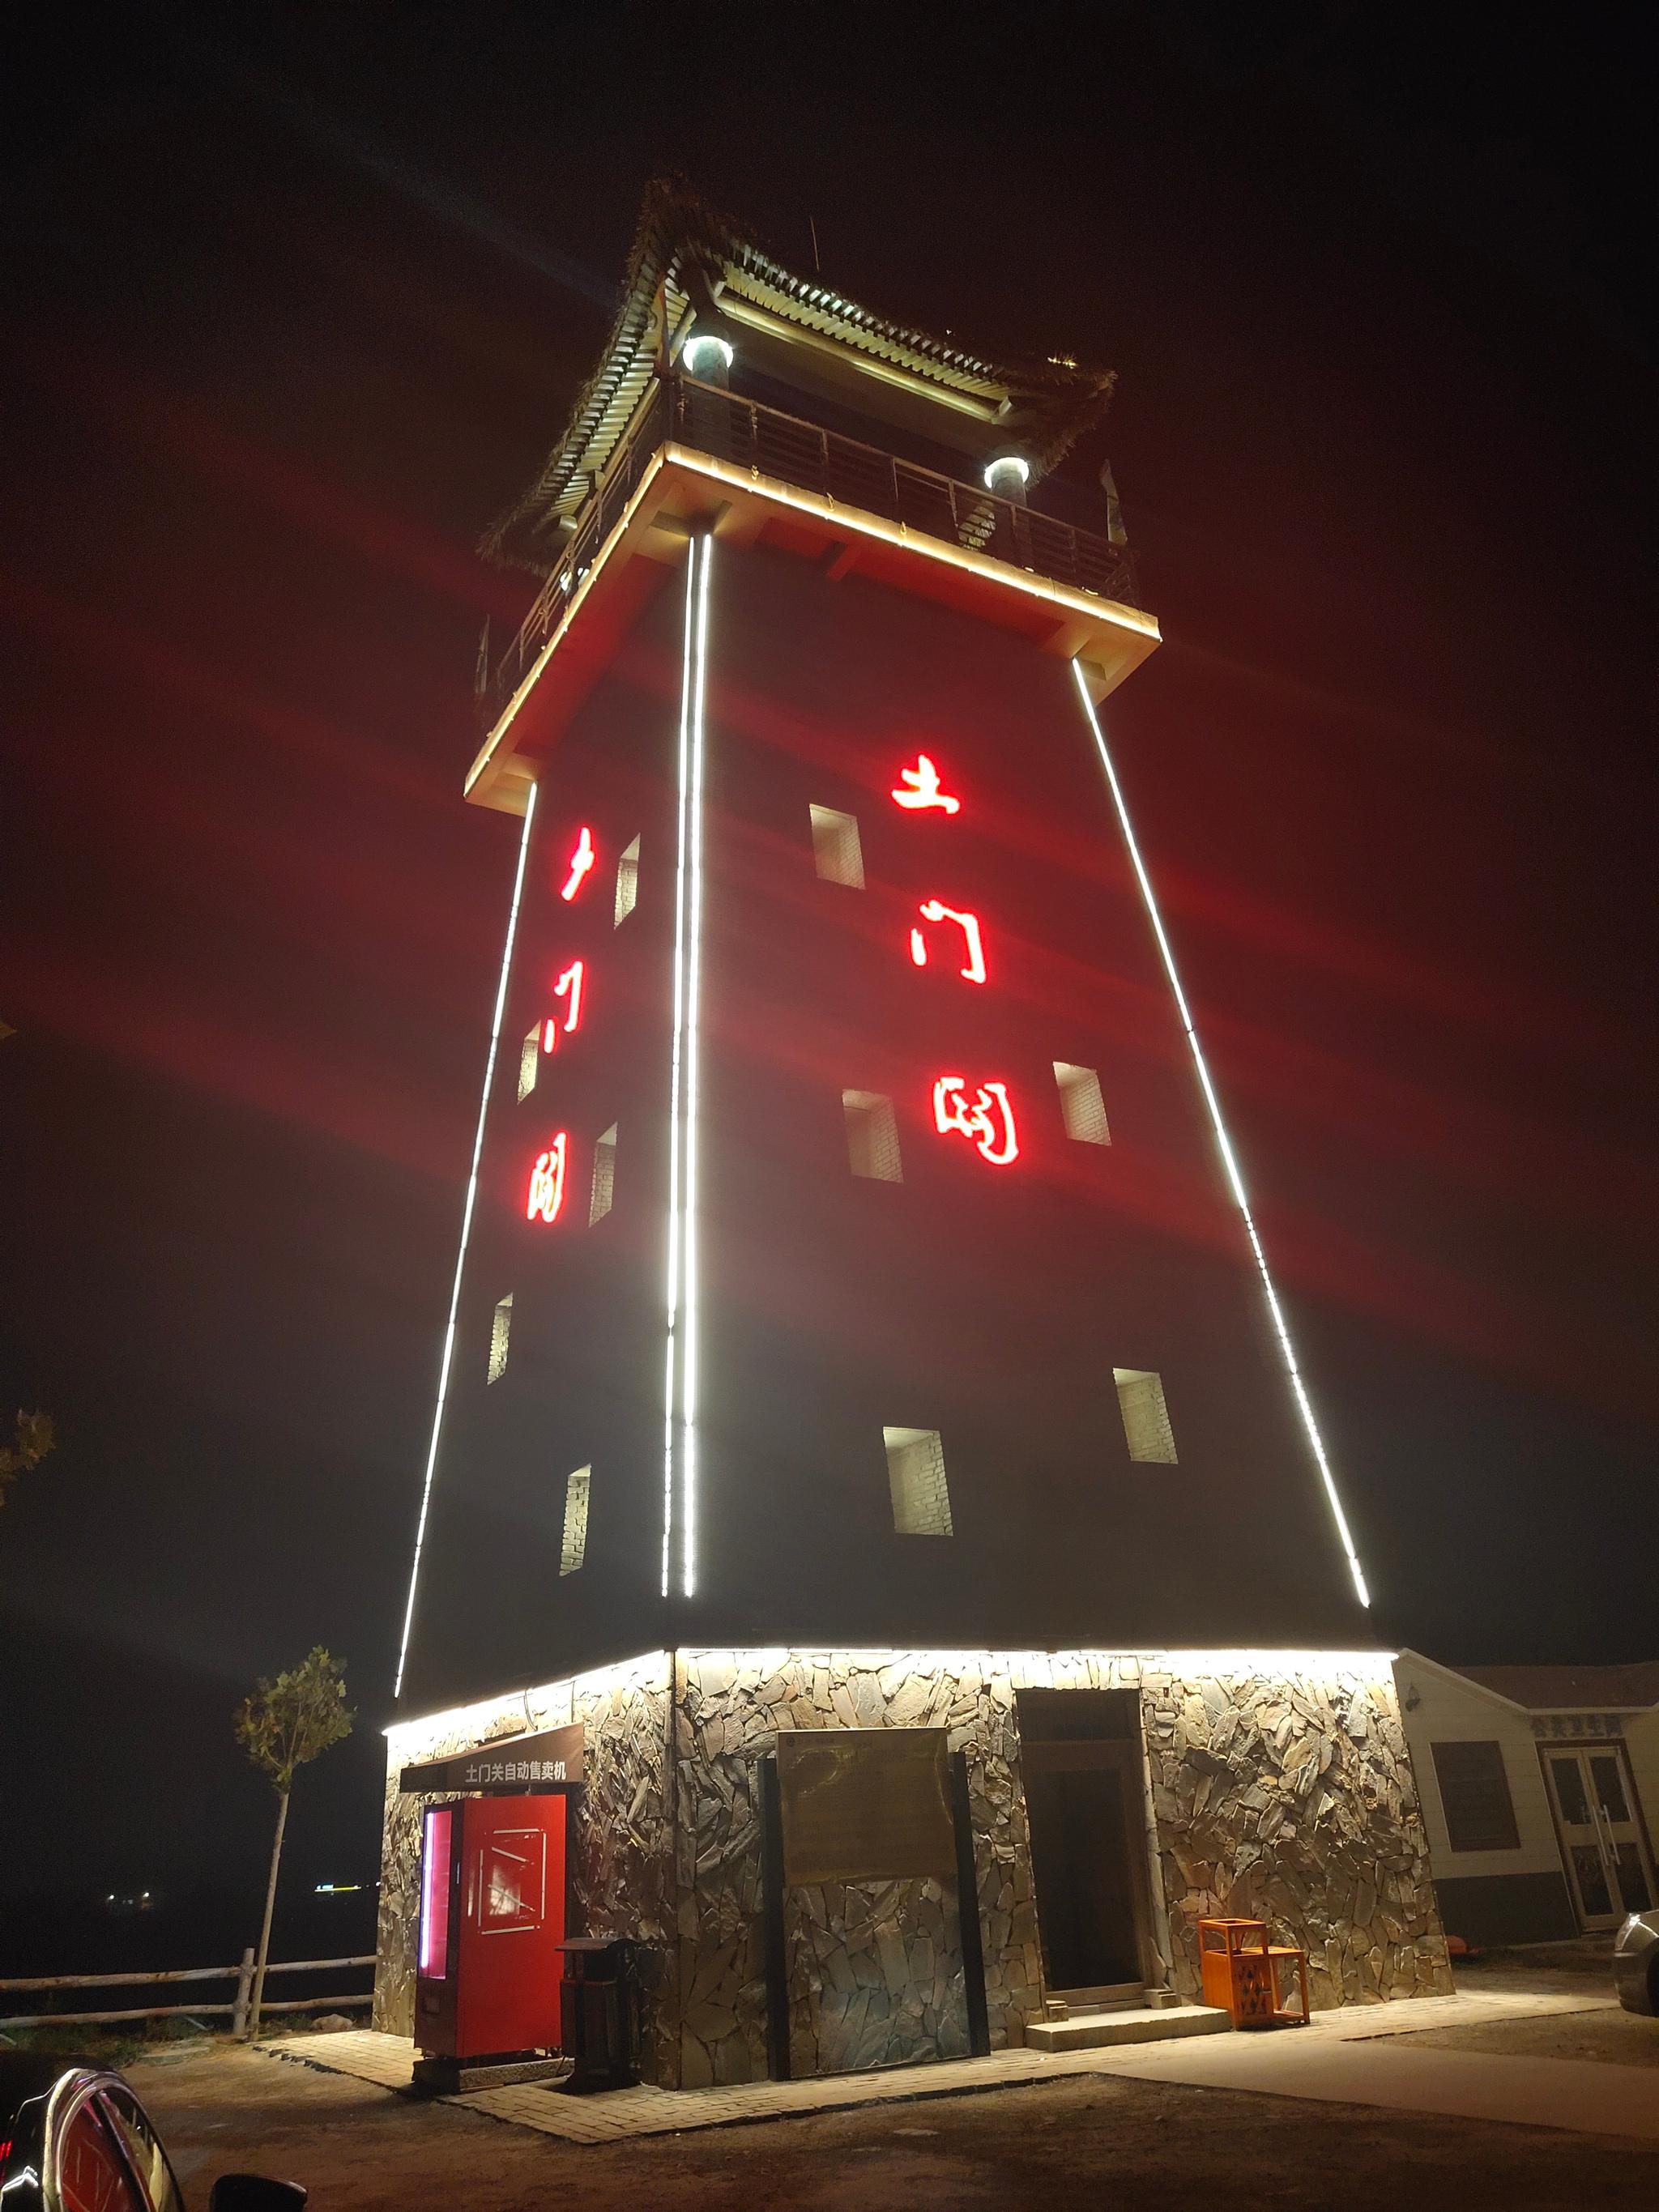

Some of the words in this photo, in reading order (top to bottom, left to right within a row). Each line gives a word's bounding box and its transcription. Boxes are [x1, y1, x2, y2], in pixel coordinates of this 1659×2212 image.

[465, 1760, 567, 1783] 土门关自动售卖机
